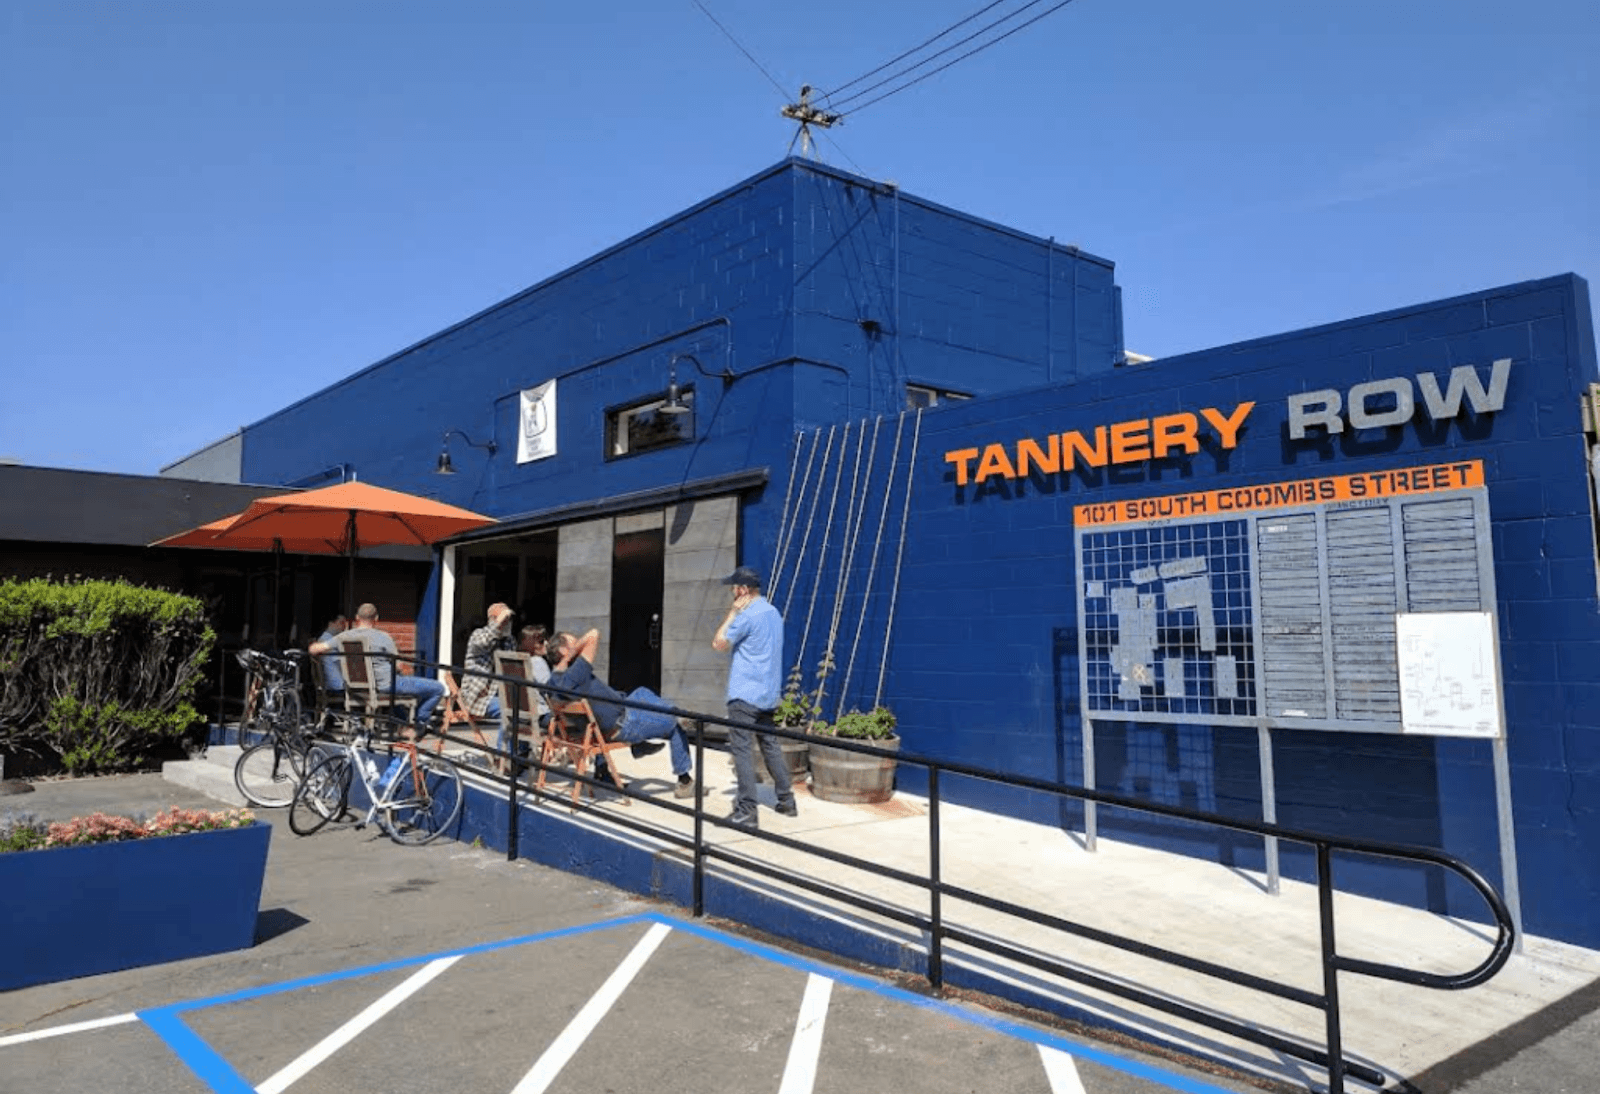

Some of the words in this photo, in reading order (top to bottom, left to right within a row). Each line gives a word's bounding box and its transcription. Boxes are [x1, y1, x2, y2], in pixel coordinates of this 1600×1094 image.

[945, 402, 1255, 485] TANNERY
[1288, 358, 1511, 439] ROW
[1082, 506, 1116, 522] 101
[1126, 495, 1206, 519] SOUTH
[1217, 479, 1335, 509] COOMBS
[1349, 464, 1472, 496] STREET
